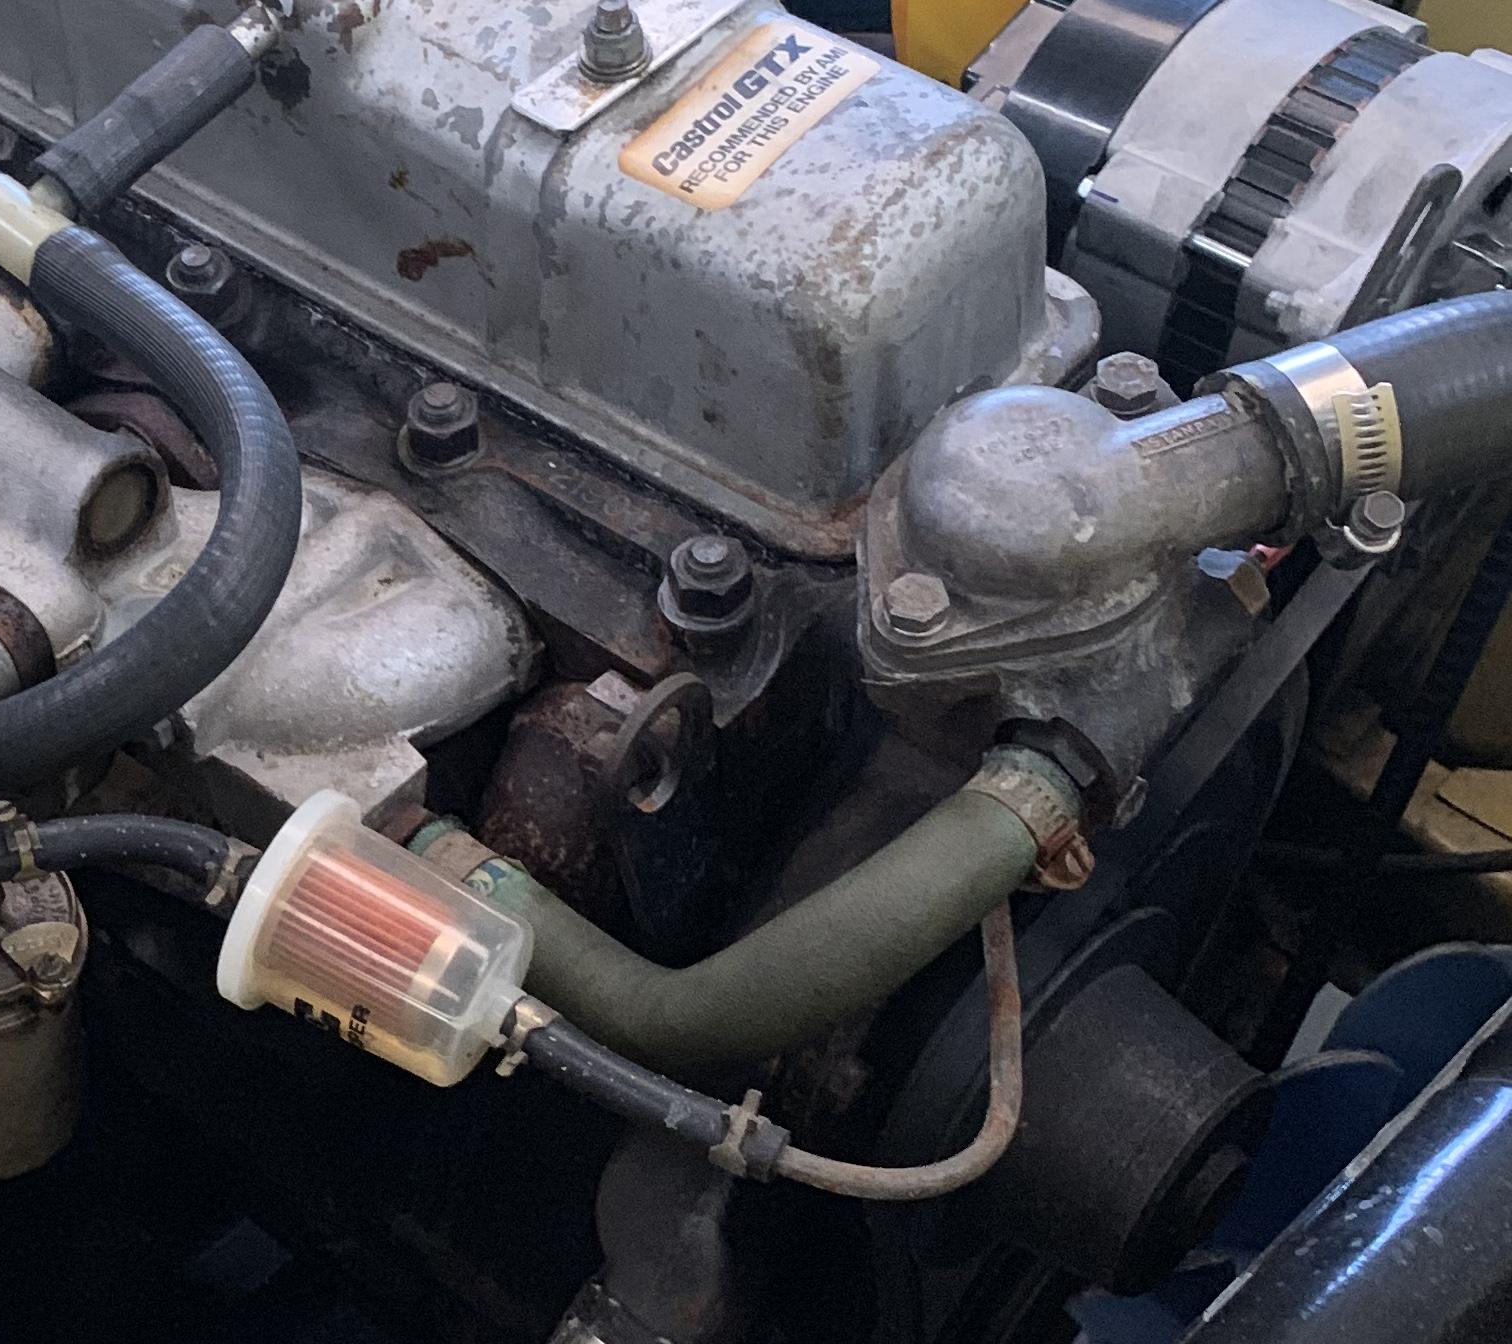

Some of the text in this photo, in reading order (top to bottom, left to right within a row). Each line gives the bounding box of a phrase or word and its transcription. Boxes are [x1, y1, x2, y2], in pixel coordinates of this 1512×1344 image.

[652, 33, 812, 178] Castrol GTX
[678, 46, 849, 194] RECOMMENDED BY AMI
[714, 64, 850, 183] FOR THIS ENGINE
